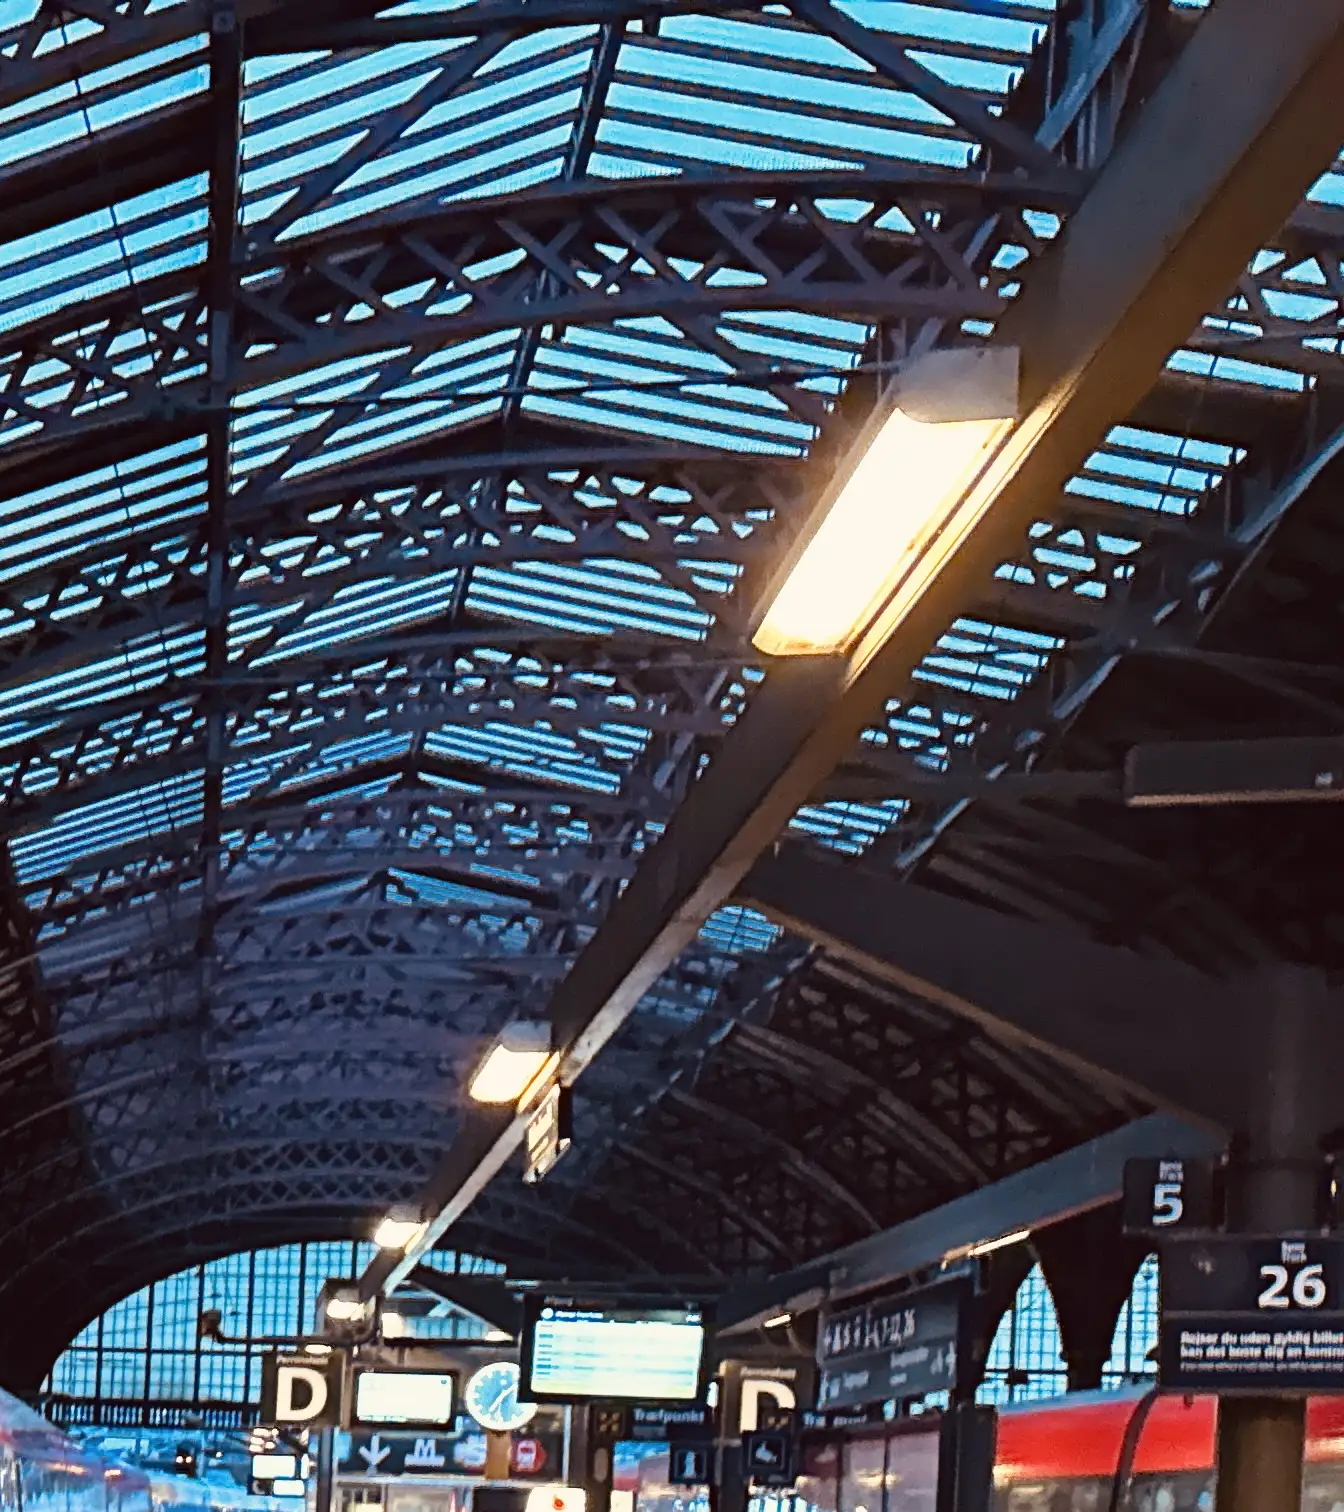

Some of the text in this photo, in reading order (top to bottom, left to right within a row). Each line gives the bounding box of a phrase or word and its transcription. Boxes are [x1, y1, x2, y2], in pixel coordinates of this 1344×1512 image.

[1151, 1183, 1183, 1226] 5
[1258, 1264, 1326, 1308] 26
[275, 1366, 328, 1421] D
